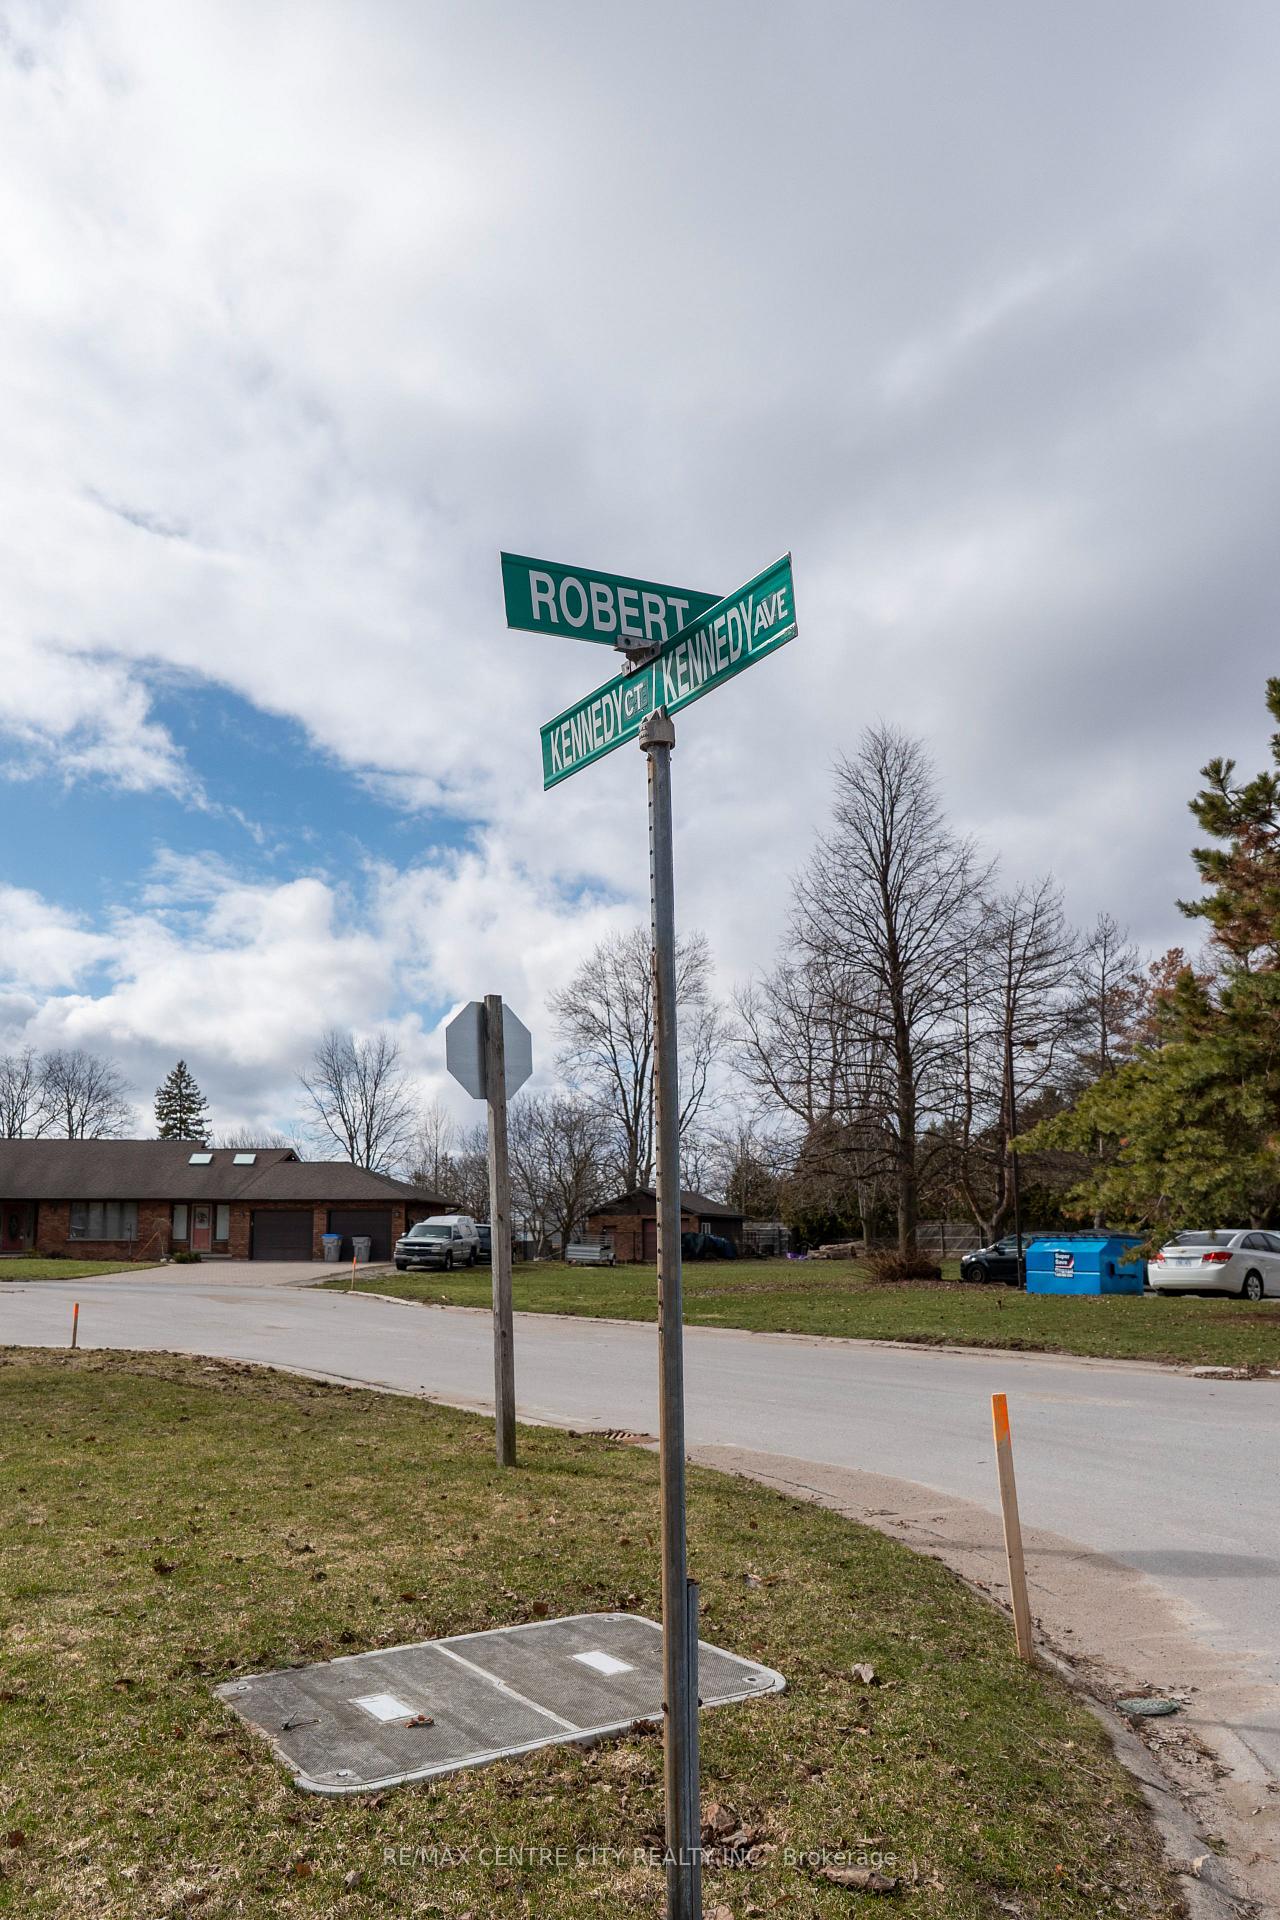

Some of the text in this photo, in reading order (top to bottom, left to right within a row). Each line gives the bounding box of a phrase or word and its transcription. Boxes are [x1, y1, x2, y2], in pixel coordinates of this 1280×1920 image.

[528, 569, 689, 641] ROBERT
[661, 588, 788, 705] KENNEDY AVE
[550, 682, 644, 774] KENNEDY CT
